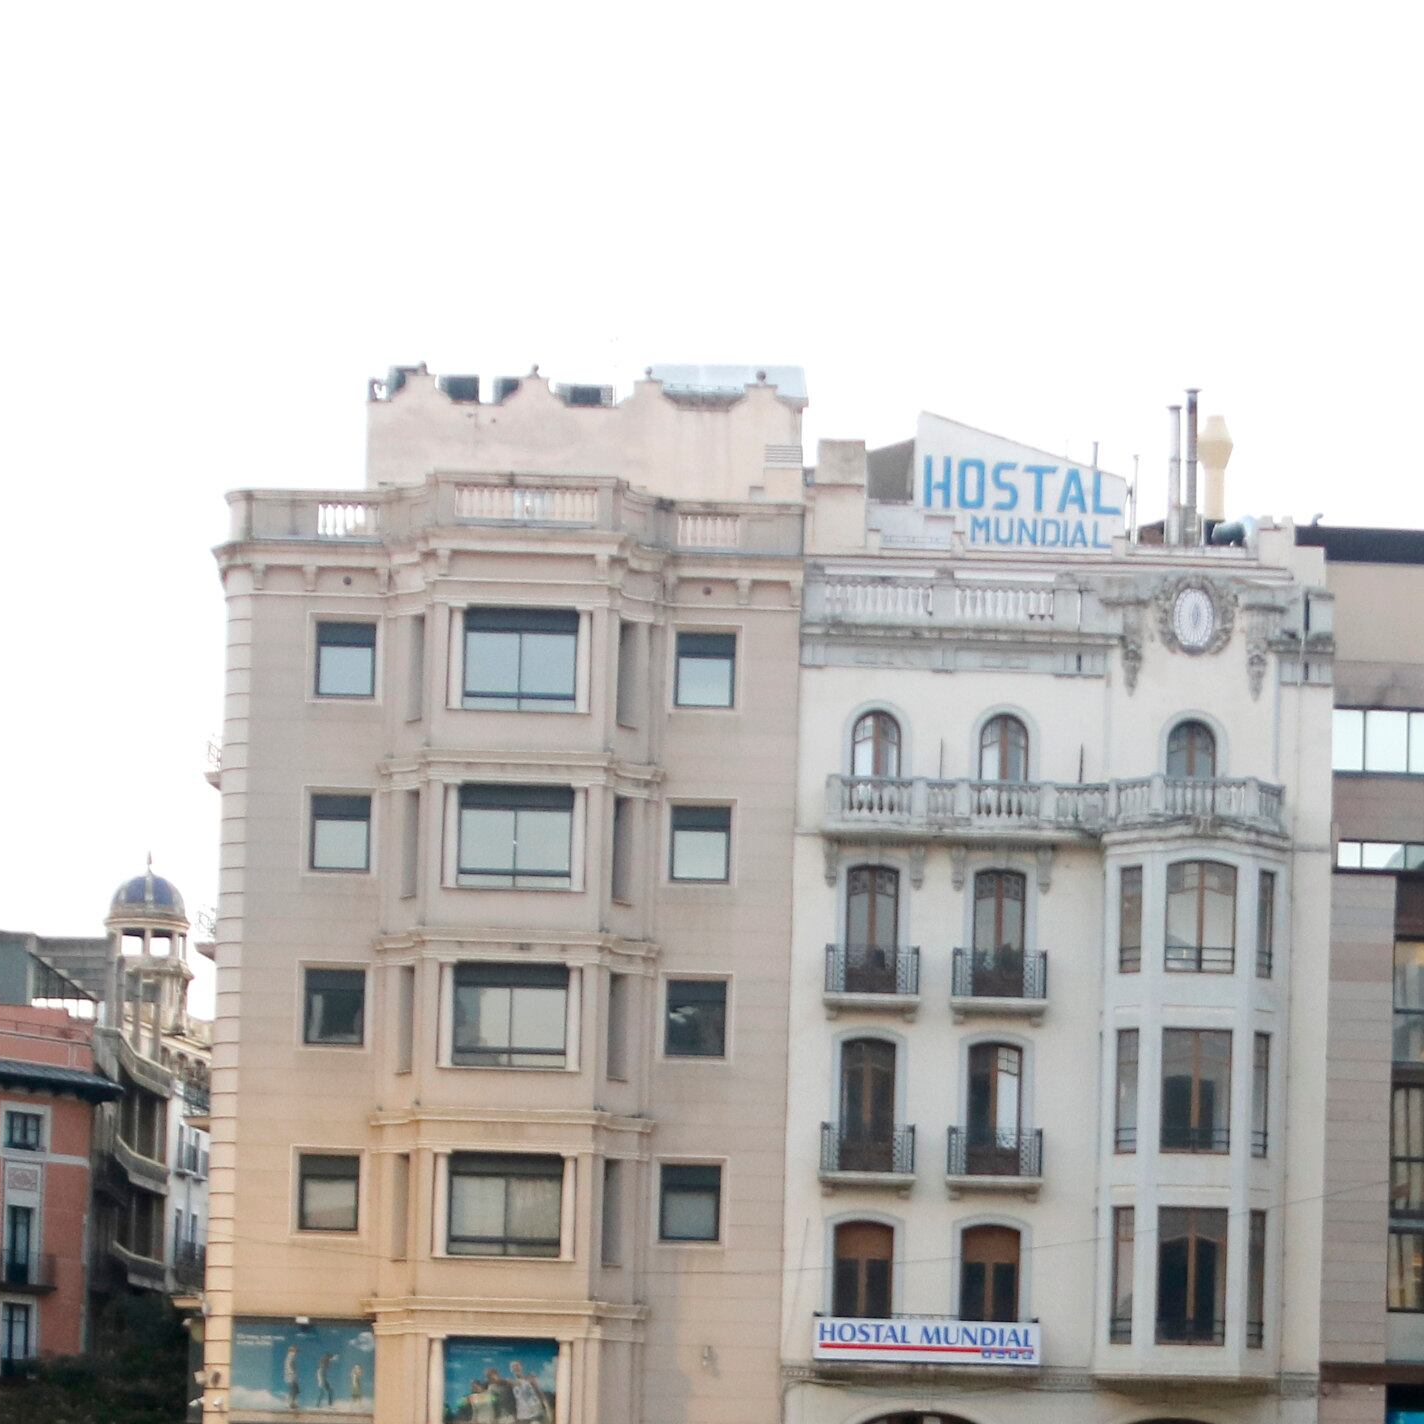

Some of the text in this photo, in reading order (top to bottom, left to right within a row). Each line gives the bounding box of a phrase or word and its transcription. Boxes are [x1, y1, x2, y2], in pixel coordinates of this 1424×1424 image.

[922, 454, 1122, 516] HOSTAL
[969, 515, 1113, 549] MUNDIAL
[818, 1321, 1034, 1348] HOSTAL MUNDIAL
